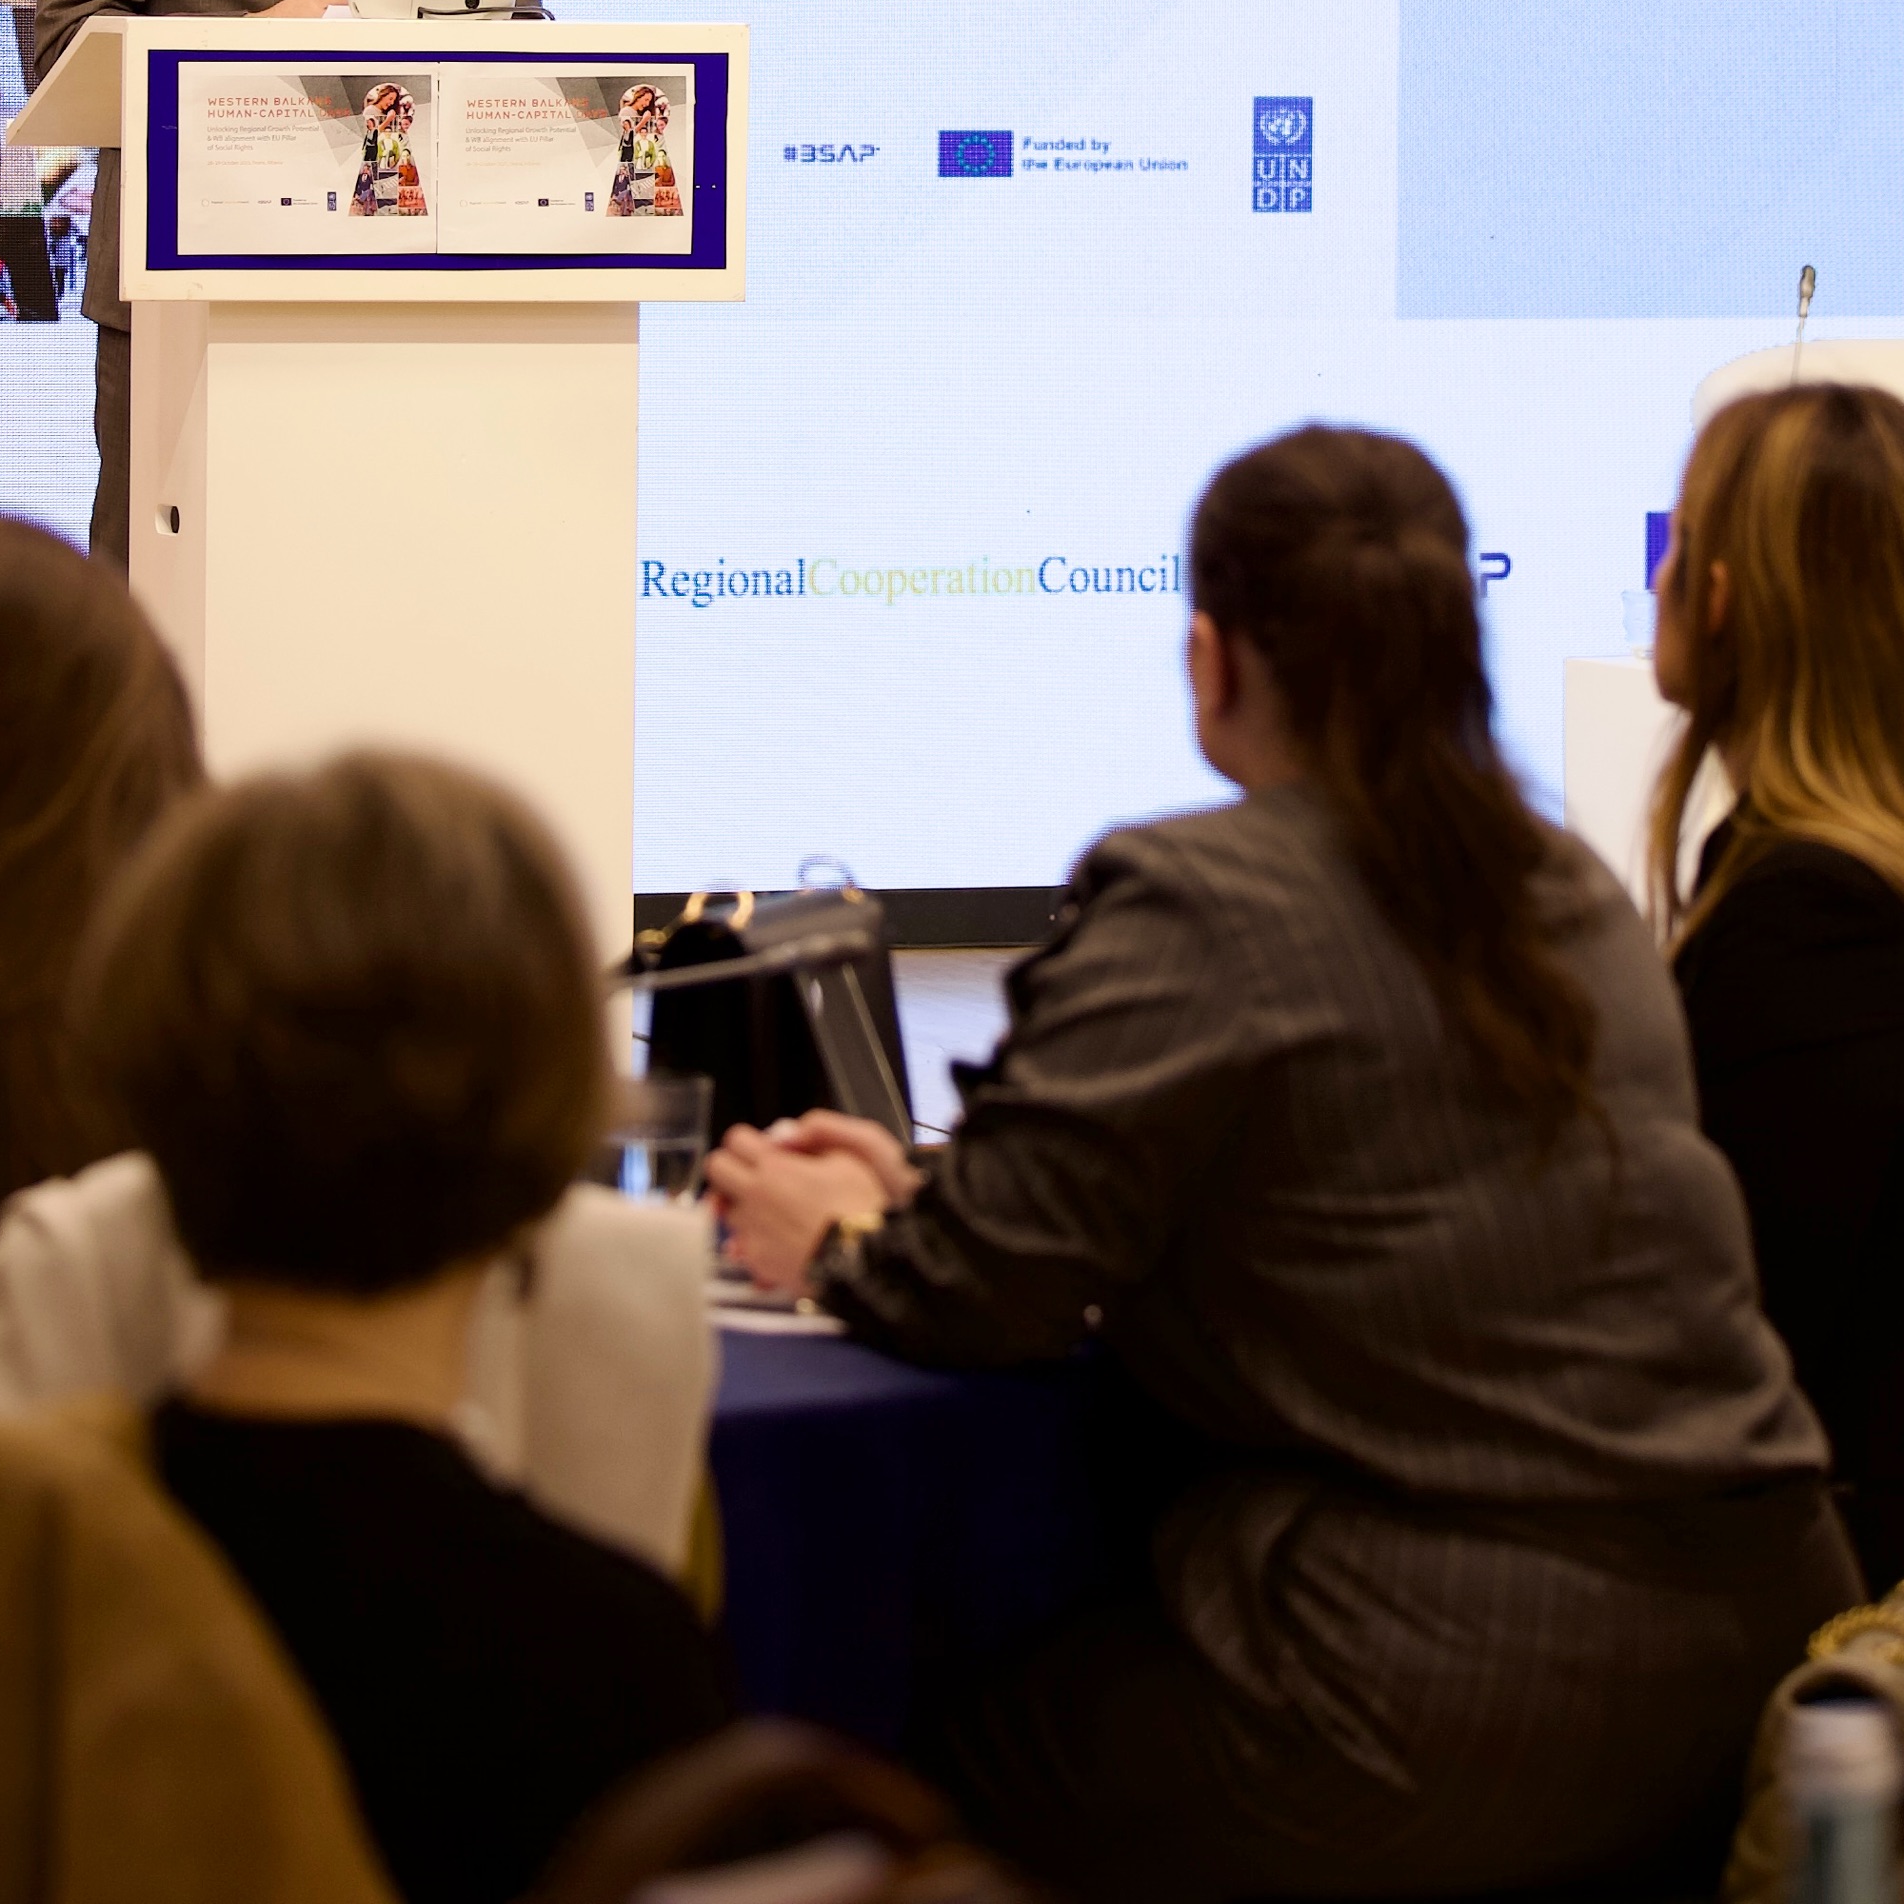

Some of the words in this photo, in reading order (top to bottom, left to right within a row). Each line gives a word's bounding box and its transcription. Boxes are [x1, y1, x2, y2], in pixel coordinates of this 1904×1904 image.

[207, 97, 269, 107] WESTERN
[467, 99, 527, 108] WESTERN
[207, 108, 314, 119] HUMAN-CAPITAL
[466, 110, 571, 120] HUMAN-CAPITAL
[1022, 136, 1086, 151] Funded
[1091, 137, 1111, 154] by
[1053, 157, 1134, 173] European
[1139, 157, 1189, 171] Union
[1257, 159, 1308, 179] UN
